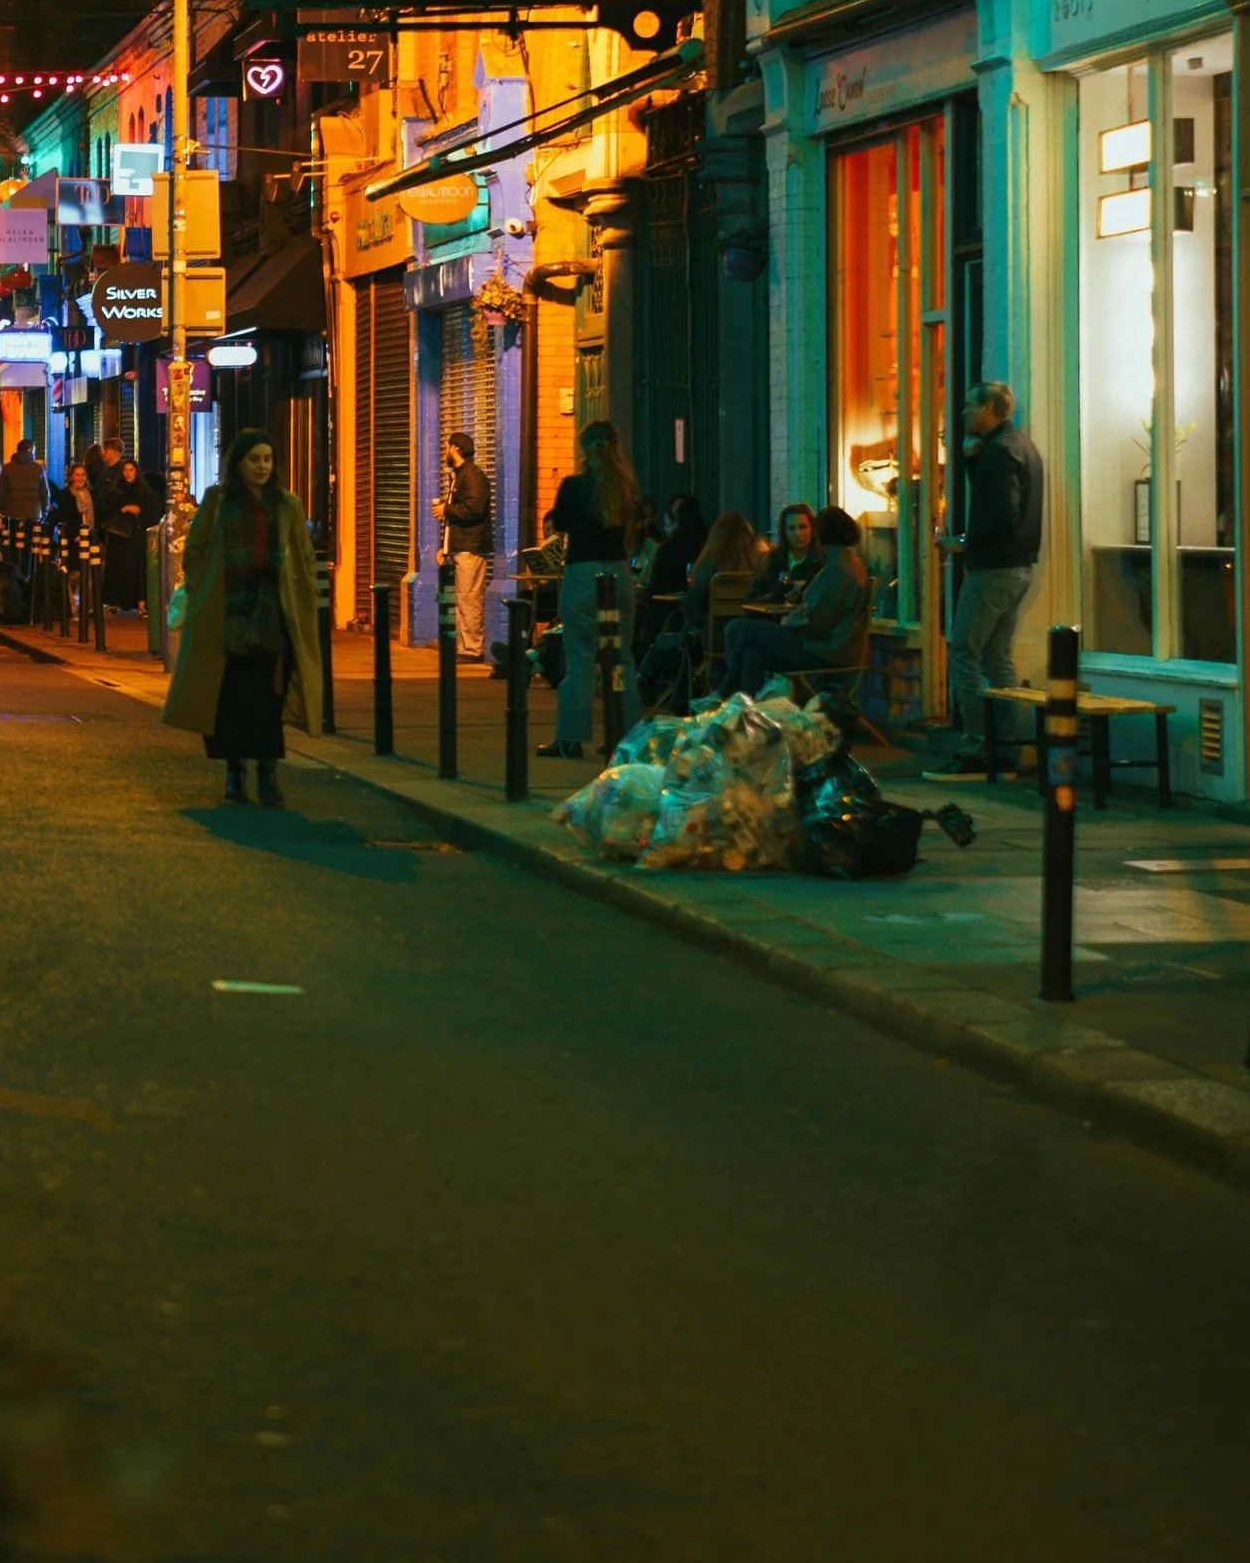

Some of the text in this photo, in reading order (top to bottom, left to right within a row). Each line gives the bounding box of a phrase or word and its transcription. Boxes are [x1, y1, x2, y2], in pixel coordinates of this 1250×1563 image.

[306, 29, 377, 43] atelier
[348, 50, 384, 75] 27
[106, 287, 157, 300] SILVER
[101, 305, 163, 319] WORKS
